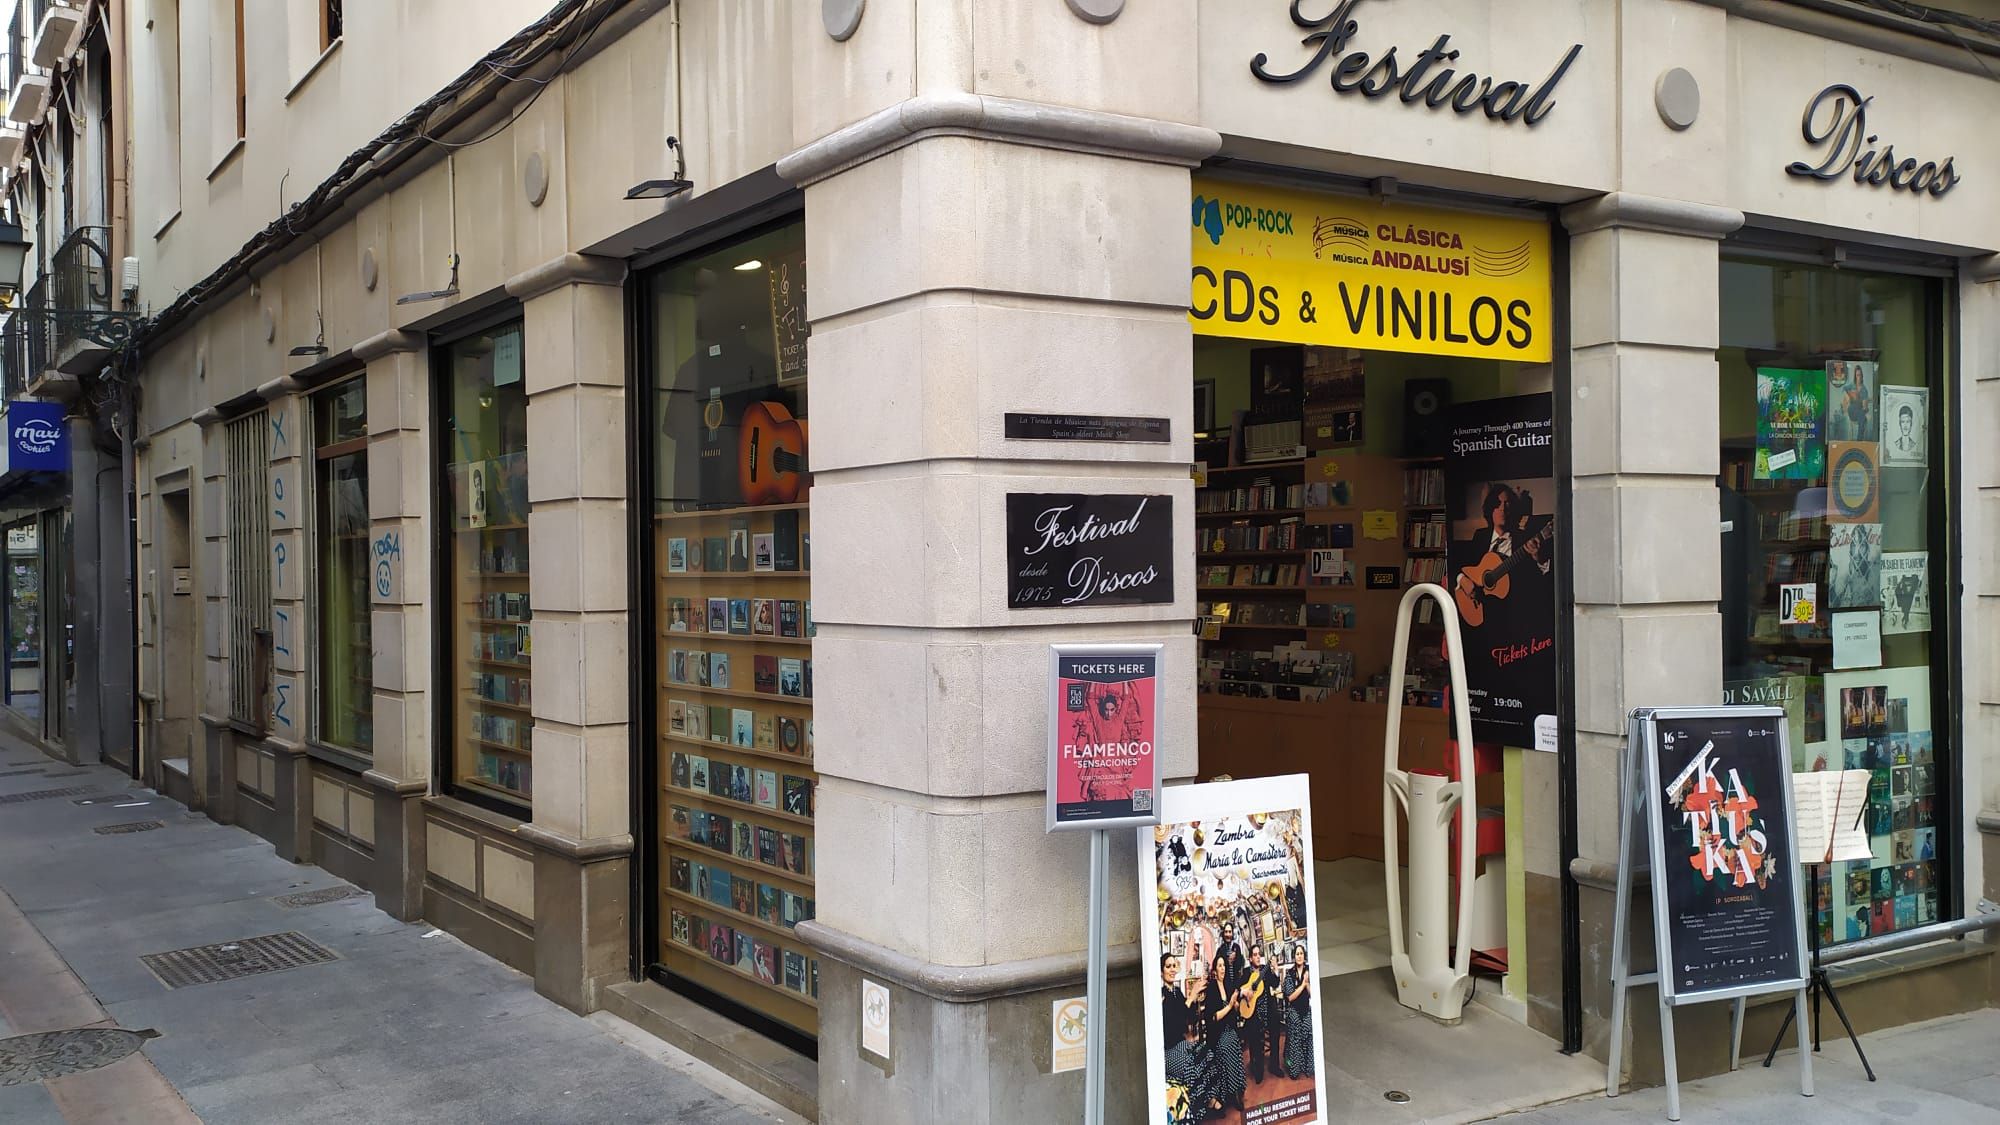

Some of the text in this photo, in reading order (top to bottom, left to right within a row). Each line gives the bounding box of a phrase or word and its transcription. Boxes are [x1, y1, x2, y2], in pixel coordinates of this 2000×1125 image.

[1250, 0, 1583, 124] Festival
[1785, 83, 1960, 197] Discos
[1226, 203, 1293, 235] POP-ROCK
[1333, 224, 1463, 249] MÚSICA CLÁSICA
[1332, 250, 1470, 276] MÚSICA ANDALUSÍ
[1190, 266, 1532, 349] CDs & VINILOS
[1453, 418, 1552, 436] A Journey Through 400 Years of
[1452, 432, 1552, 457] Spanish Guitar
[1023, 498, 1148, 555] Festival
[1018, 556, 1158, 604] desde Discos
[1014, 586, 1054, 603] 1975
[1491, 637, 1553, 667] Tickets here
[1072, 664, 1145, 674] TICKETS HERE
[1493, 697, 1523, 709] 19:00h
[1742, 685, 1794, 703] SAVALL
[1663, 731, 1675, 744] 16
[1064, 742, 1151, 759] FLAMENCO
[1214, 824, 1256, 846] Zambra
[1203, 844, 1287, 871] María La Canastera
[1251, 863, 1288, 880] Sacromonte
[1246, 1108, 1262, 1119] HAGA
[1263, 1105, 1271, 1114] SU
[1272, 1098, 1296, 1111] RESERVA
[1263, 1113, 1279, 1123] YOUR
[1279, 1107, 1297, 1119] TICKET
[1297, 1104, 1311, 1113] HERE
